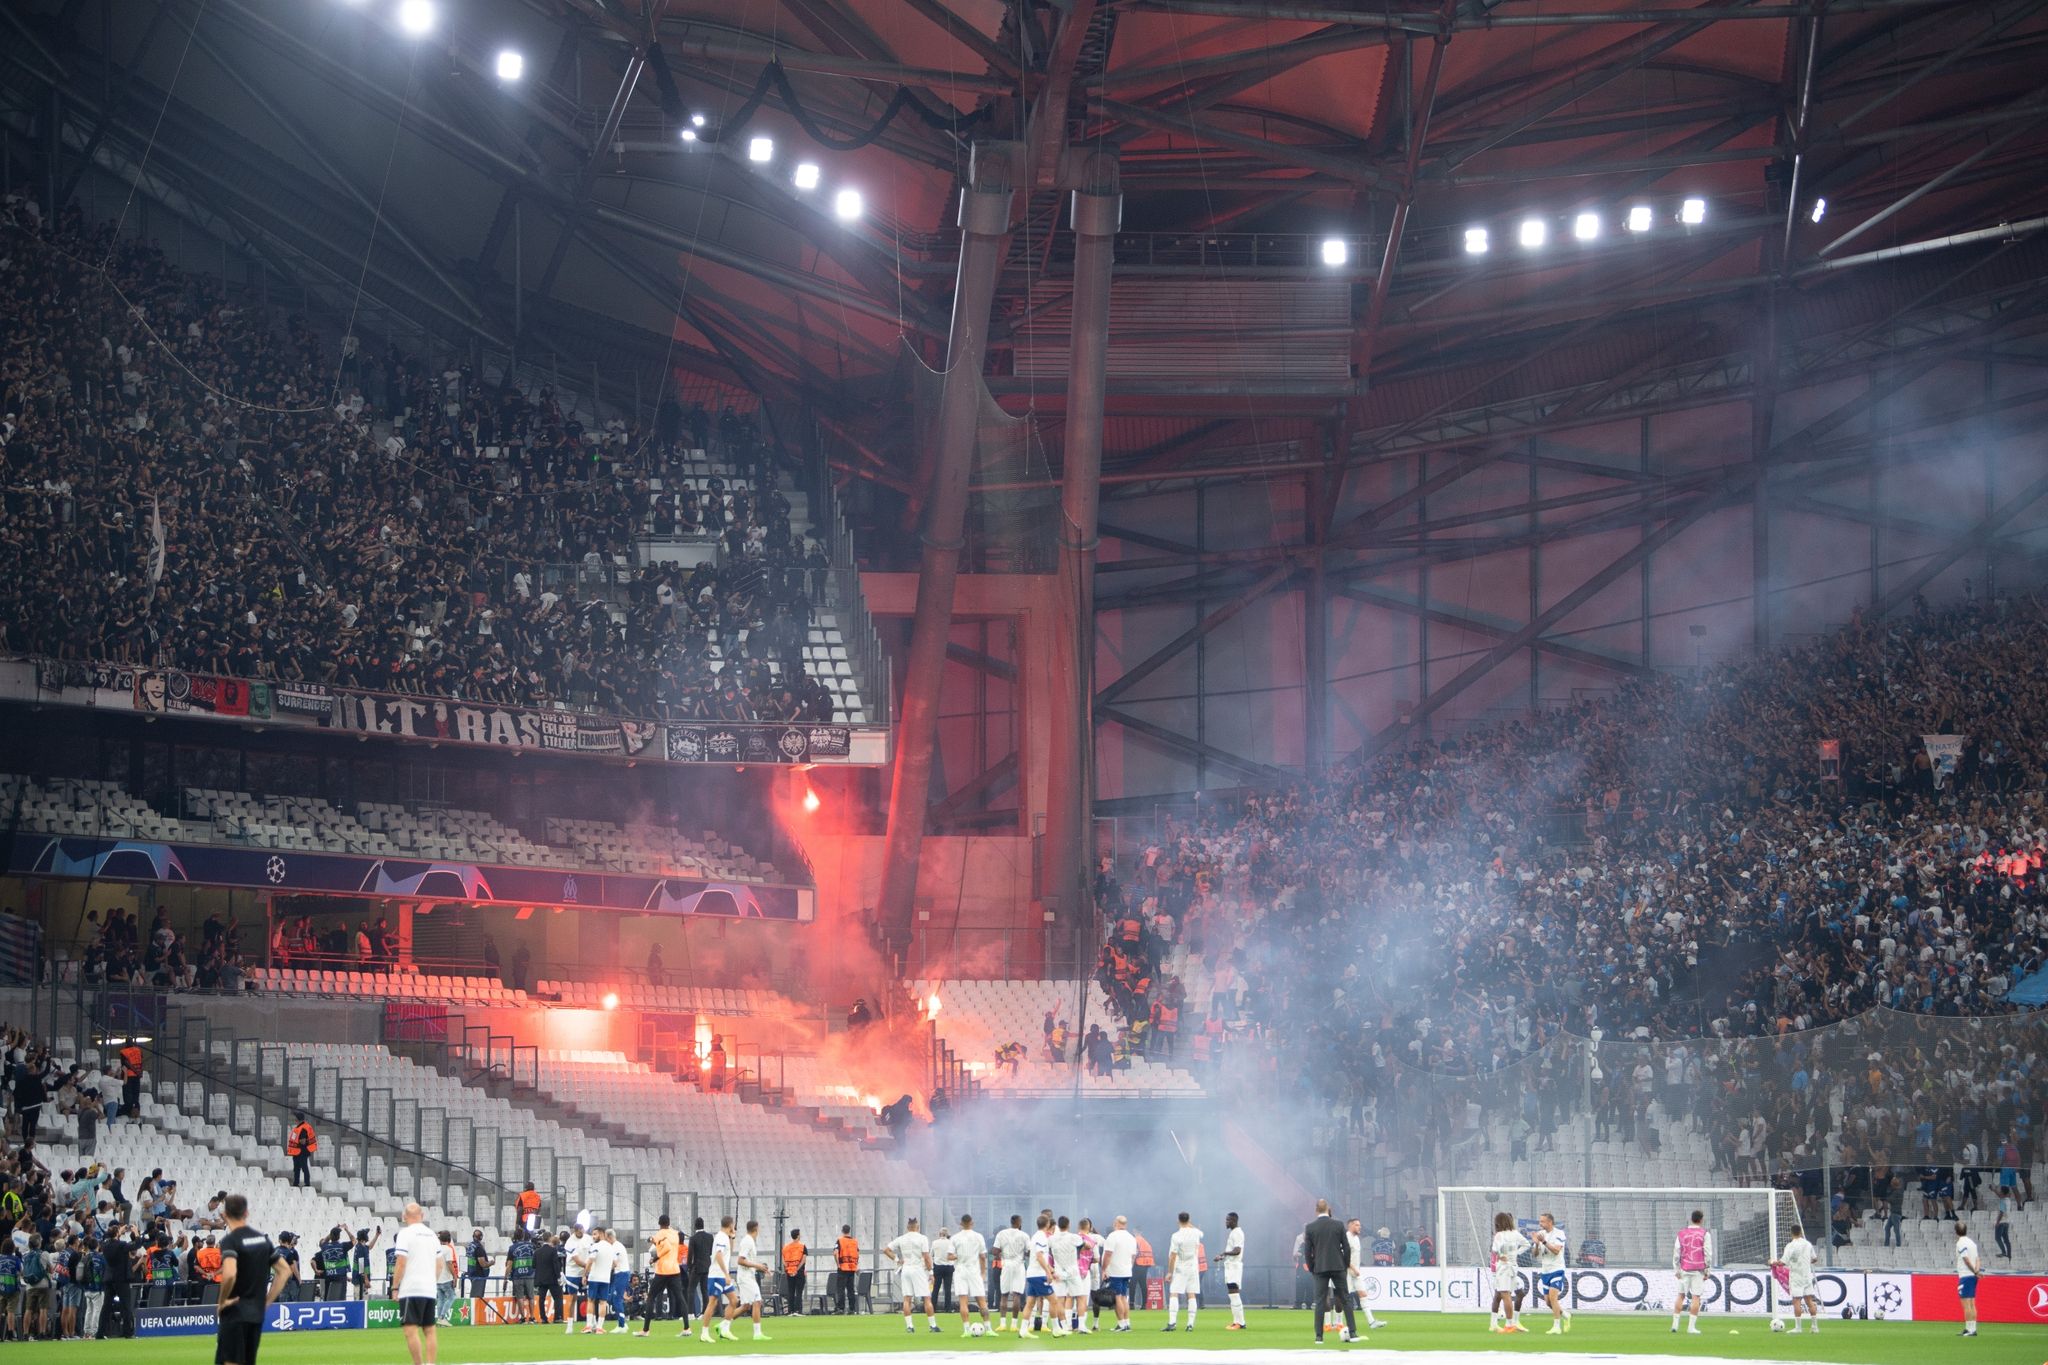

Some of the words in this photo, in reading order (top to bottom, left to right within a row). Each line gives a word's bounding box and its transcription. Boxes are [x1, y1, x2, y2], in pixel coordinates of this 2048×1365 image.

[278, 694, 332, 712] SURRENDER
[140, 1318, 164, 1328] UEFA
[165, 1315, 215, 1327] CHAMPIONS
[298, 1306, 347, 1326] PS5
[368, 1306, 396, 1323] enjoy
